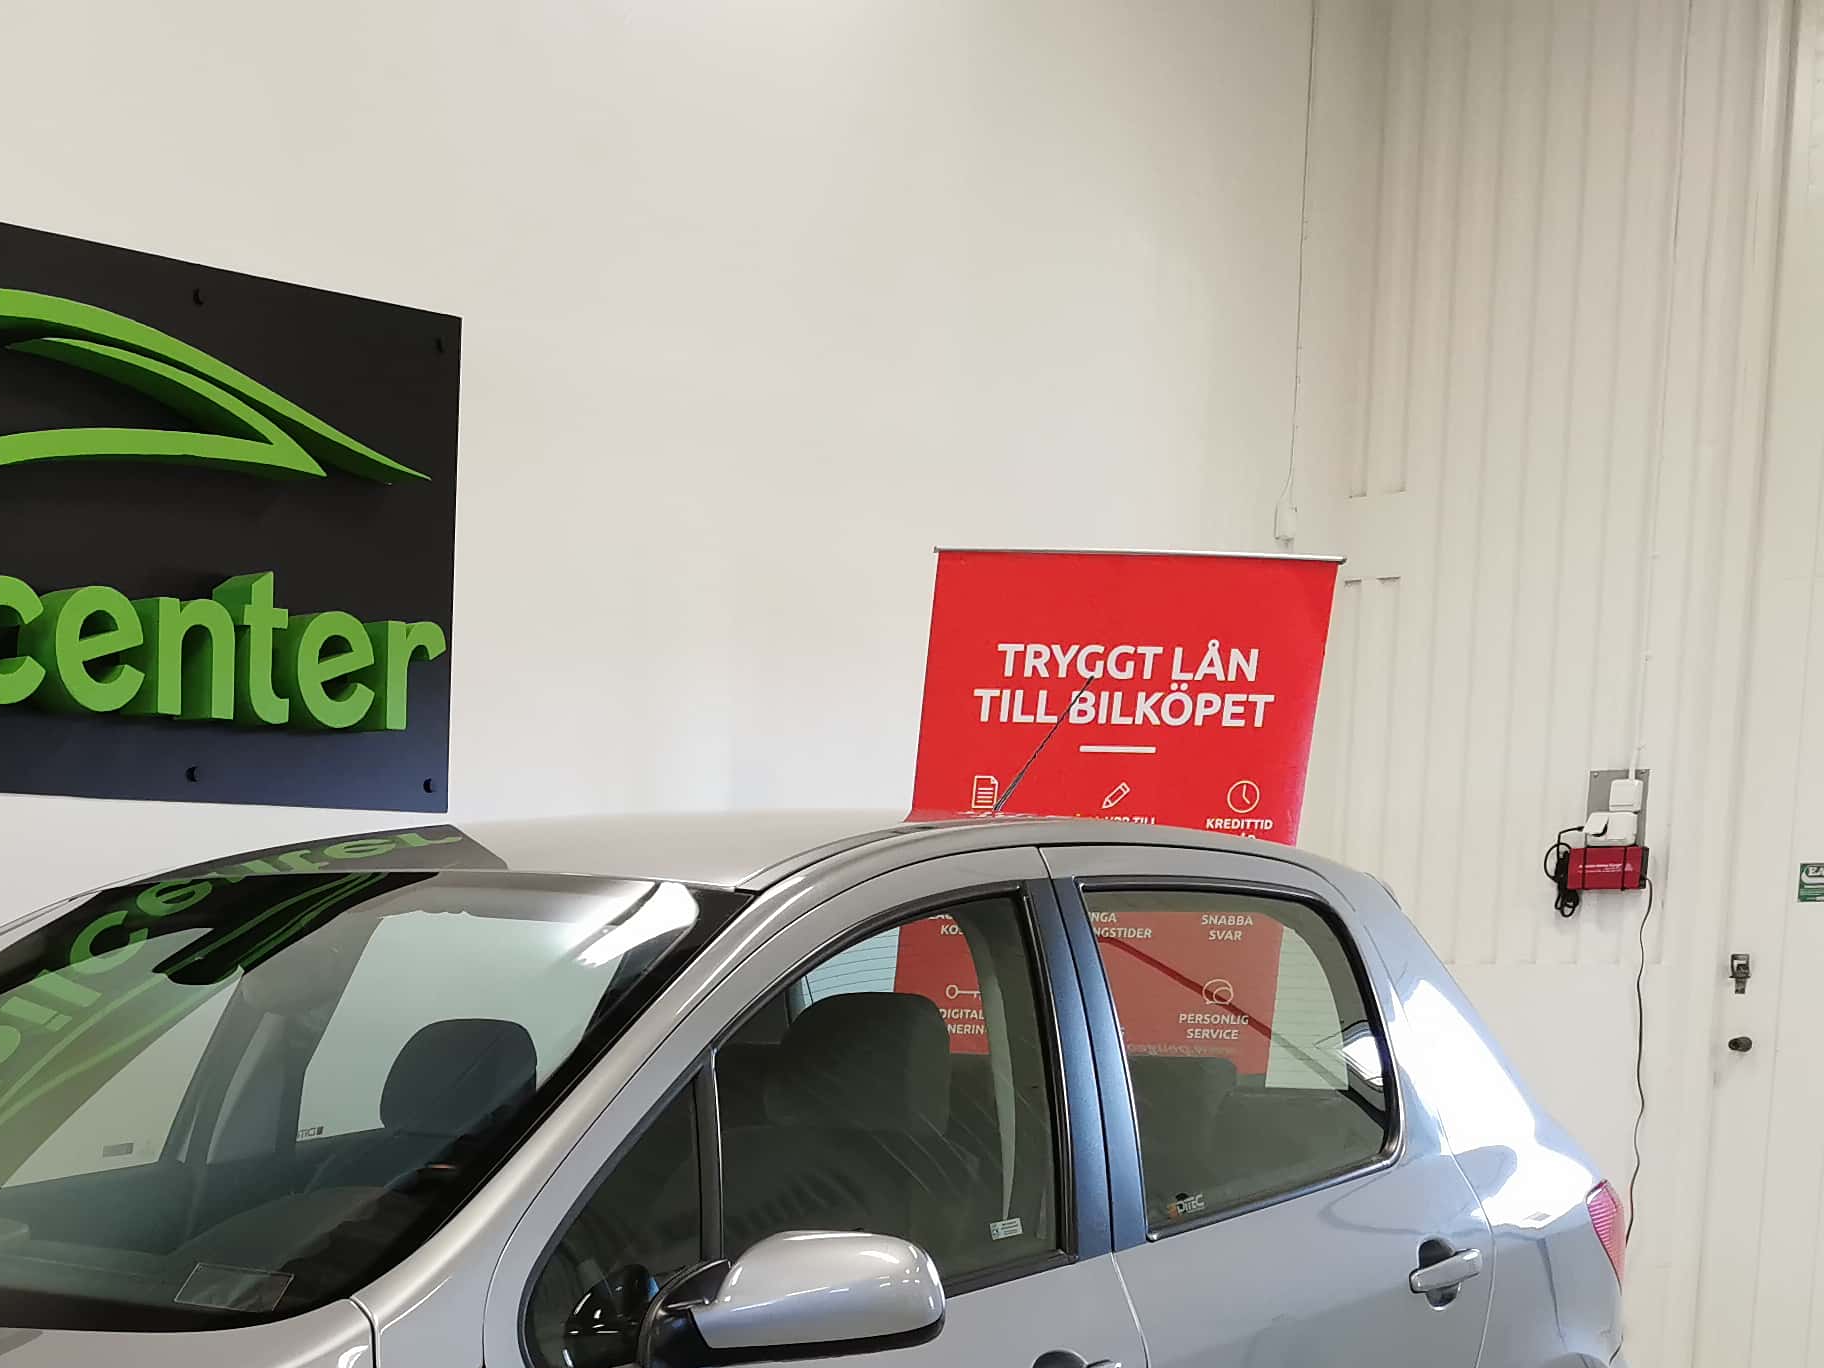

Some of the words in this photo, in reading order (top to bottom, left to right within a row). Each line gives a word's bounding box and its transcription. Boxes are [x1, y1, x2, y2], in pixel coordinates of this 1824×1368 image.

[997, 643, 1163, 680] TRYGGT
[1172, 638, 1259, 682] LÅN
[973, 688, 1059, 723] TILL
[1068, 681, 1275, 728] BILKÖPET
[1206, 818, 1273, 830] KREDITTID
[1089, 912, 1117, 923] NGA
[1201, 914, 1253, 926] SNABBA
[1093, 927, 1152, 939] NGSTIDER
[1208, 930, 1243, 941] SVAR
[1179, 1013, 1249, 1026] PERSONLIG
[947, 1024, 987, 1035] NERIN
[1187, 1028, 1239, 1040] SERVICE
